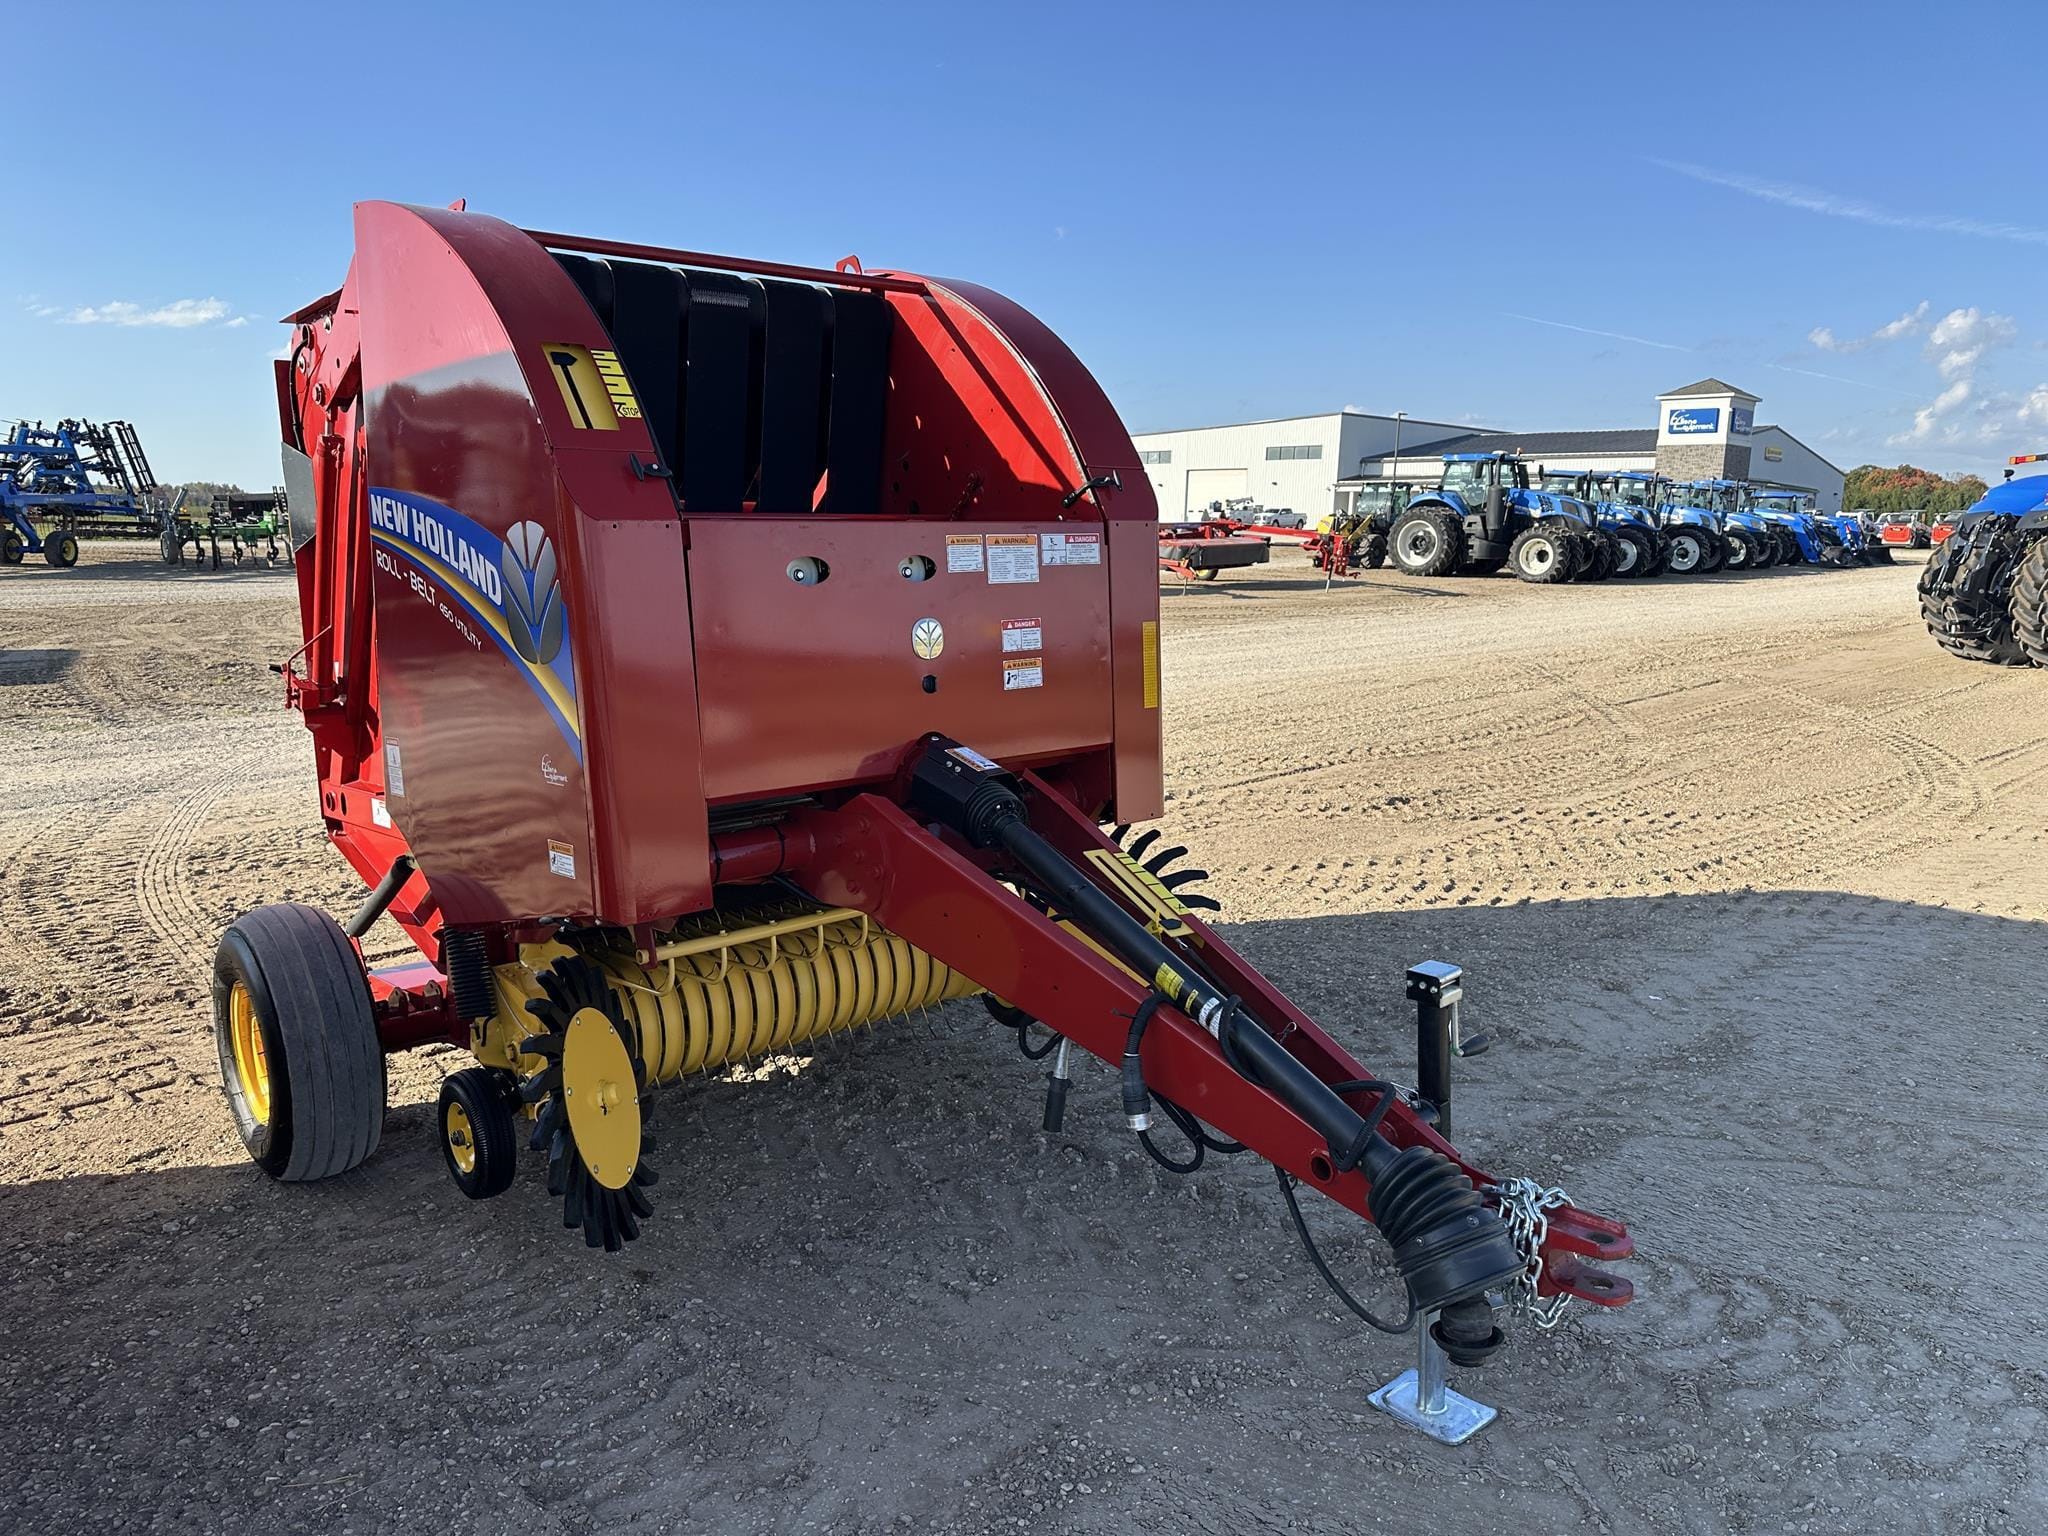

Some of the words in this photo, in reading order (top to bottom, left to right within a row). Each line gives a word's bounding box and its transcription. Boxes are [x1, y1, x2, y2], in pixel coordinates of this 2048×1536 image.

[622, 407, 639, 416] STOP
[1074, 535, 1097, 543] DANGER
[370, 494, 409, 537] NEW
[411, 508, 502, 606] HOLLAND
[375, 549, 402, 580] ROLL
[410, 570, 436, 607] BELT
[454, 616, 482, 651] UTILITY
[1014, 620, 1036, 628] DANGER
